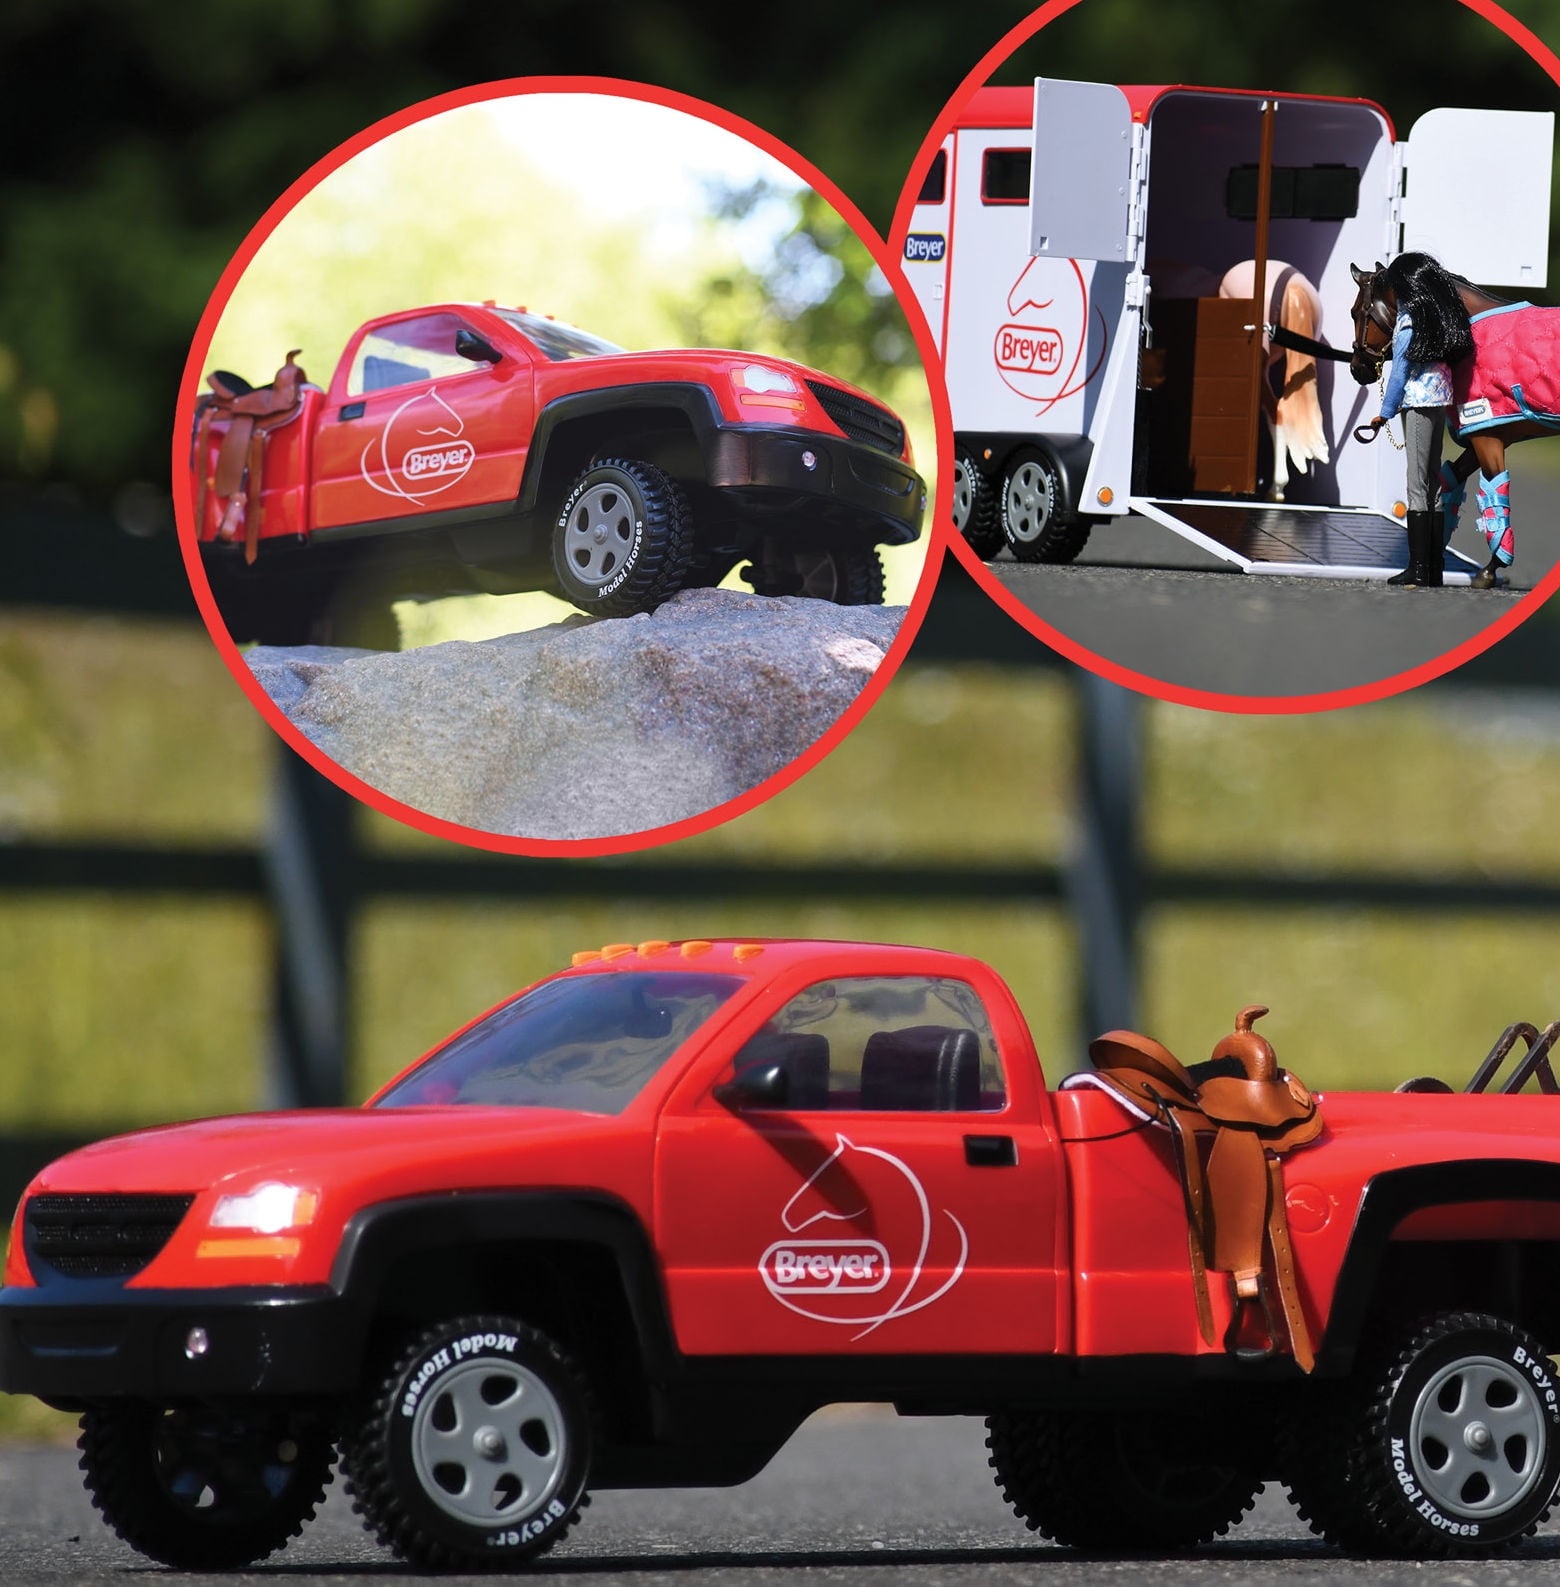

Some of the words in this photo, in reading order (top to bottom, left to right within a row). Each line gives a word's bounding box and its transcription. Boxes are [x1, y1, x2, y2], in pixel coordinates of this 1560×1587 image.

[906, 237, 943, 260] Breyer
[598, 568, 628, 597] Model
[625, 520, 643, 572] Horses
[452, 1333, 518, 1359] Model
[402, 1348, 451, 1416] Horses
[1391, 1437, 1422, 1503] Model
[1416, 1500, 1480, 1537] Horses
